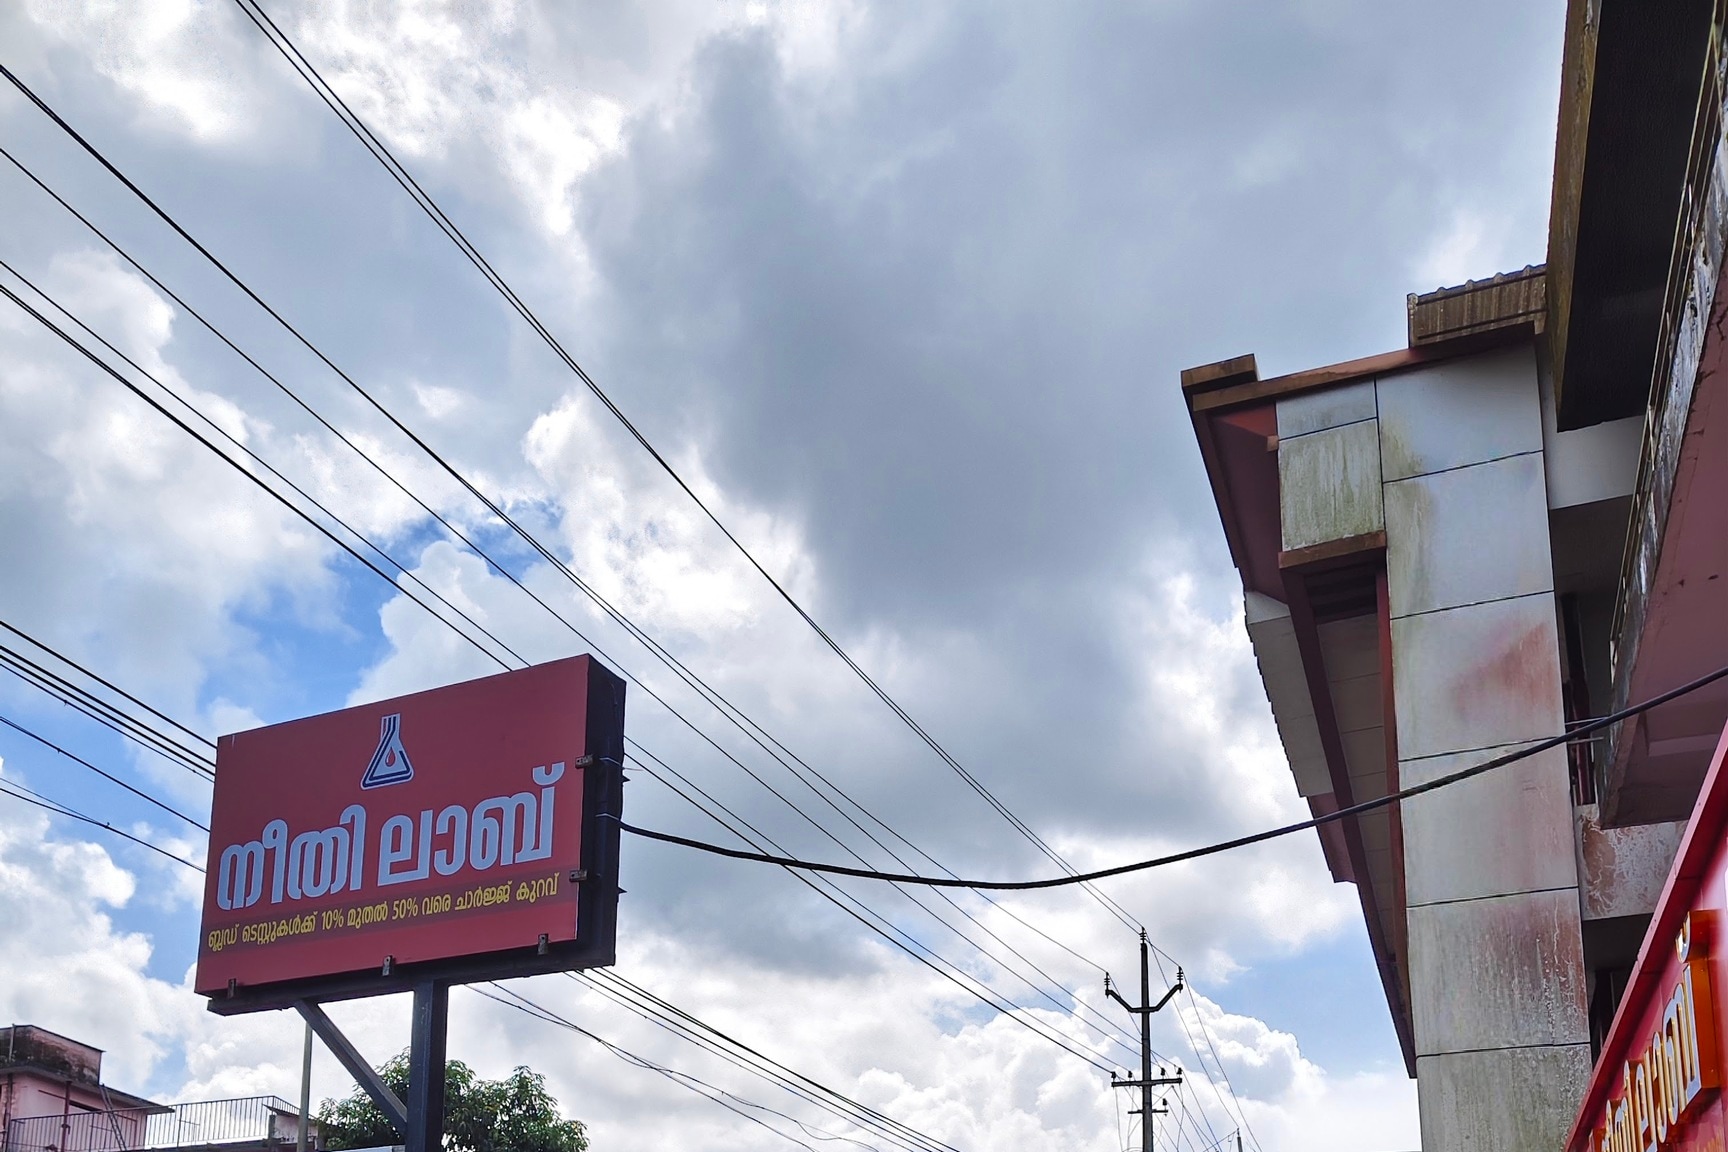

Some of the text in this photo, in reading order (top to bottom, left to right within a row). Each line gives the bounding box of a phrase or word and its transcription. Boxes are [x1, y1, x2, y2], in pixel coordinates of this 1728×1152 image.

[217, 760, 566, 911] നീതി ലാബ്
[321, 908, 344, 931] 10%
[347, 901, 389, 930] മുതൽ
[392, 897, 419, 921] 50%
[422, 893, 451, 916] വരെ
[516, 872, 560, 903] കുറവ്
